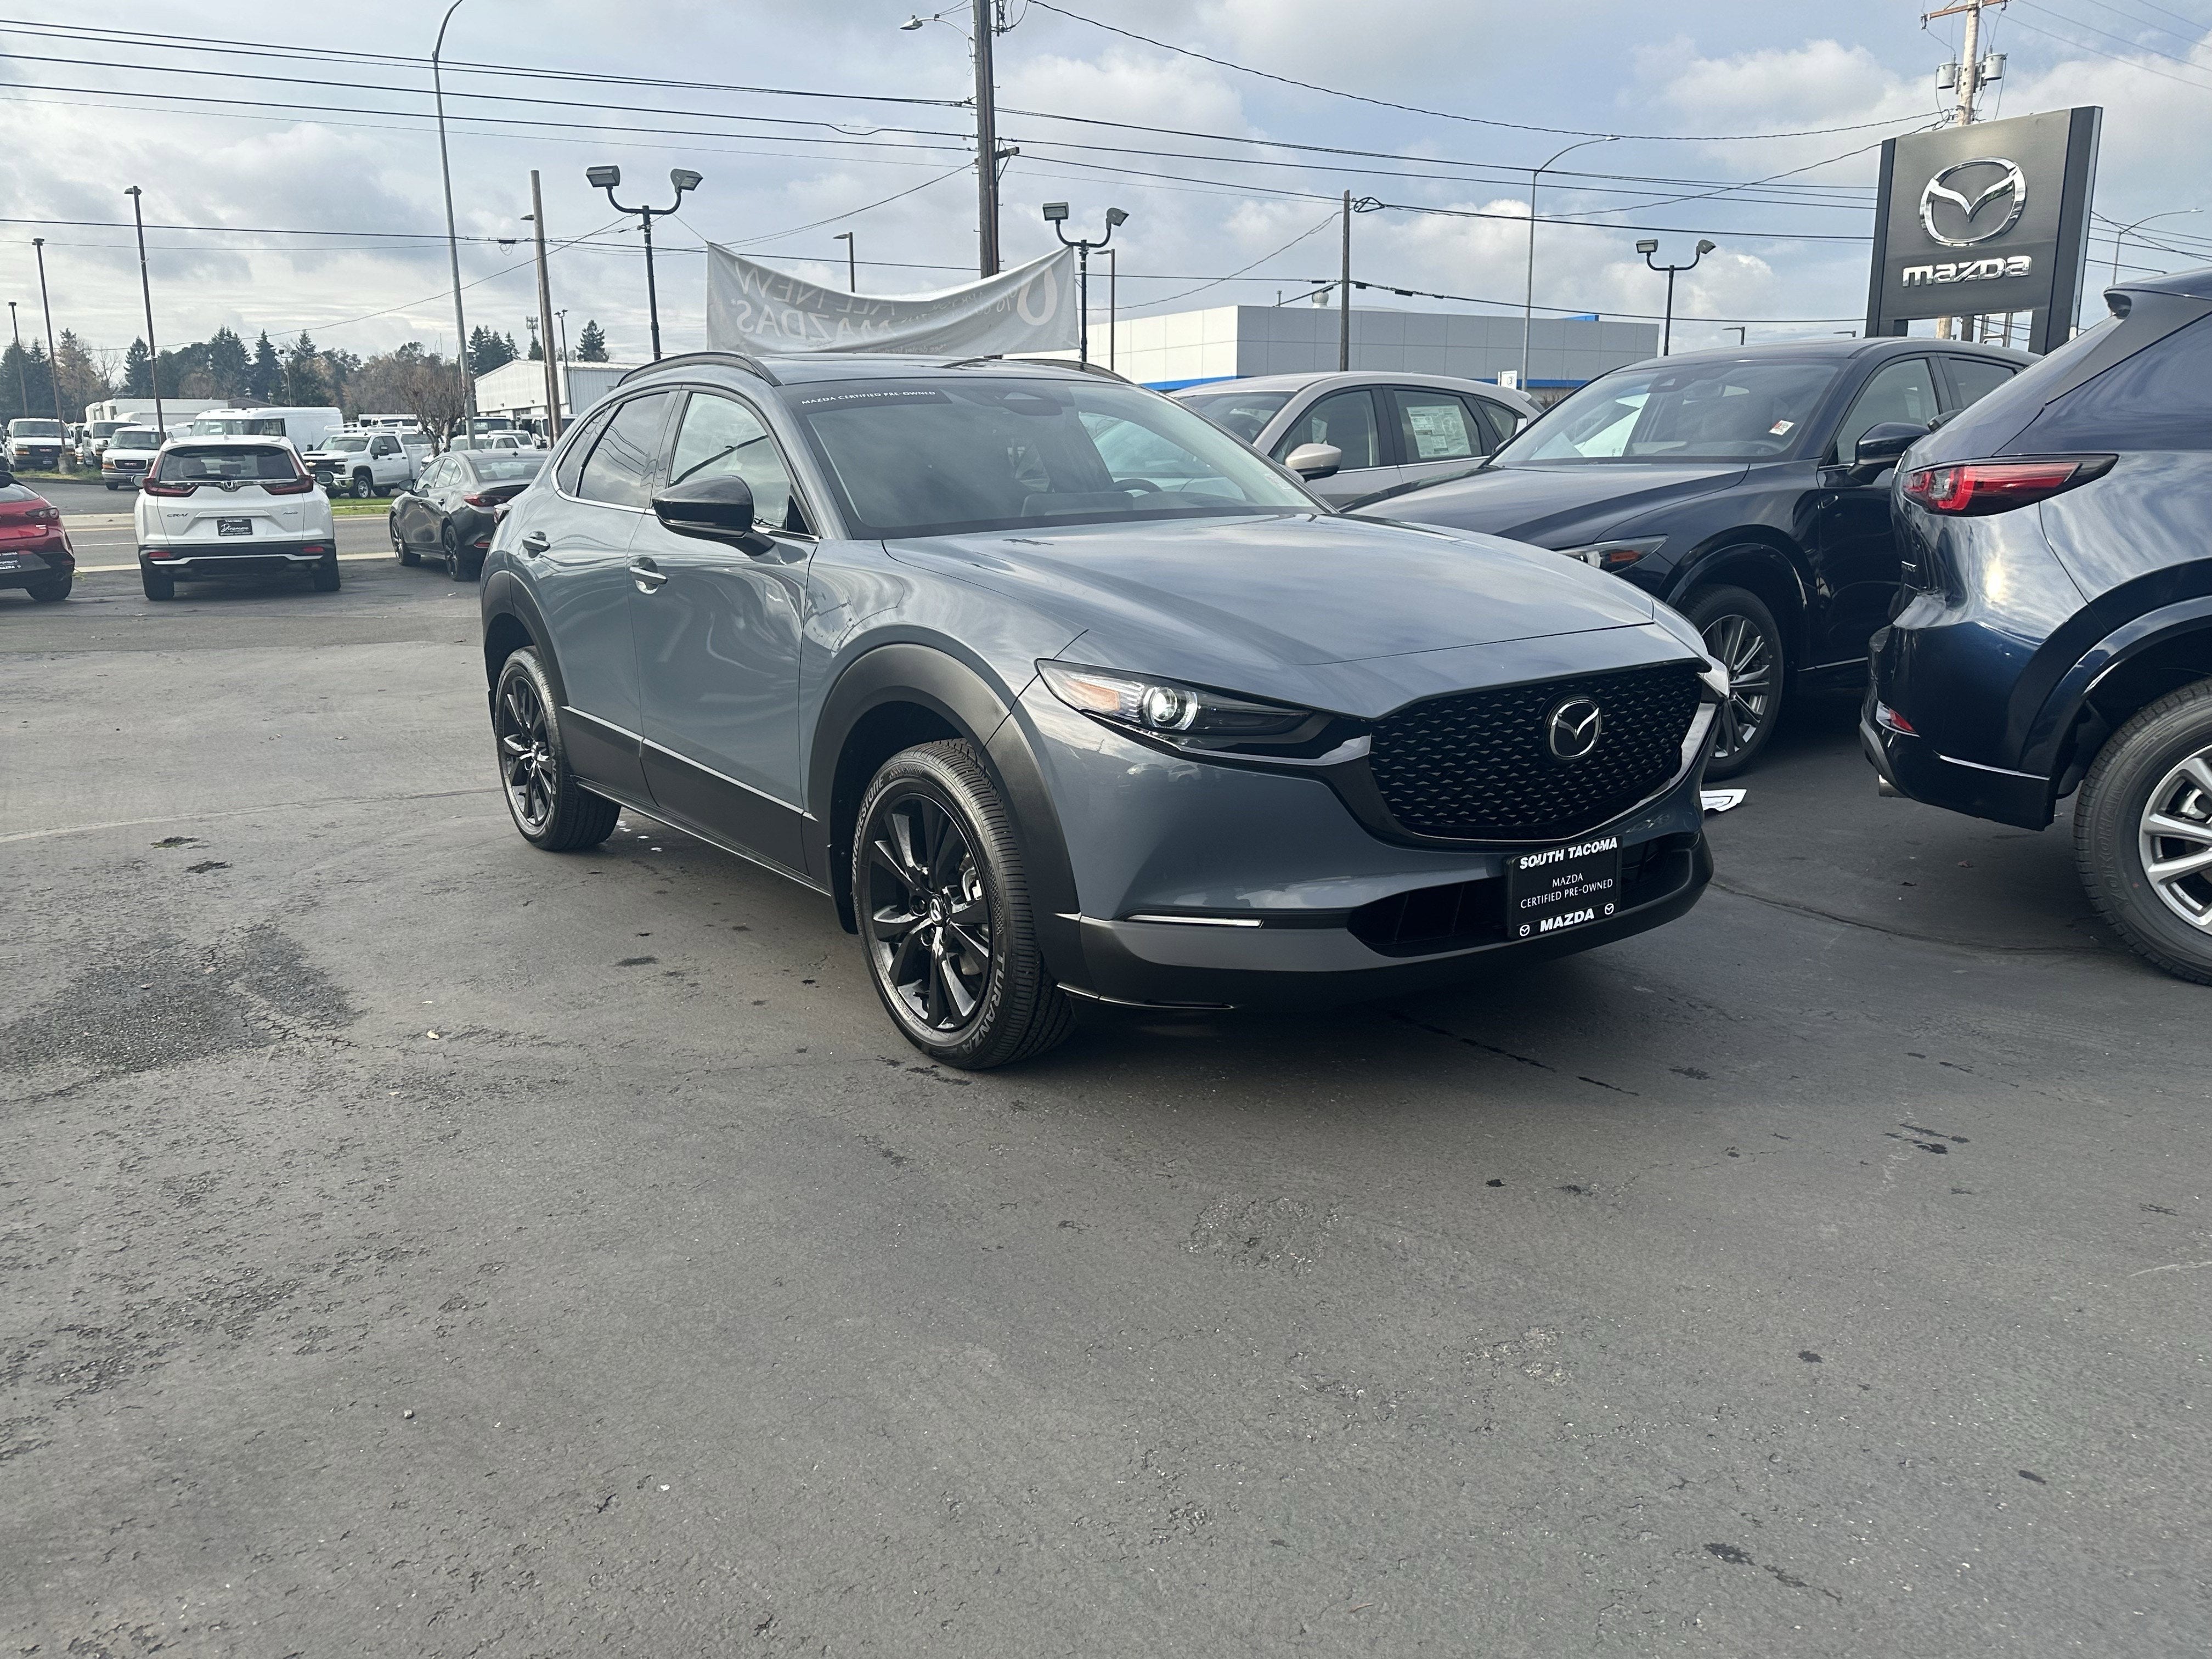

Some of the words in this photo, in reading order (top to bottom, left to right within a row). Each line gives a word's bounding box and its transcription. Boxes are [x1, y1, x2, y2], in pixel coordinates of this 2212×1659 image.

[802, 397, 836, 405] MAZDA
[852, 774, 884, 884] BRIDGESTONE
[1519, 849, 1565, 870] SOUTH
[1567, 837, 1618, 859] TACOMA
[1520, 891, 1562, 909] CERTIFIED
[1564, 878, 1613, 898] PRE-OWNED
[1551, 872, 1583, 888] MAZDA
[1539, 908, 1595, 933] MAZDA
[962, 951, 1006, 1054] TURANZA
